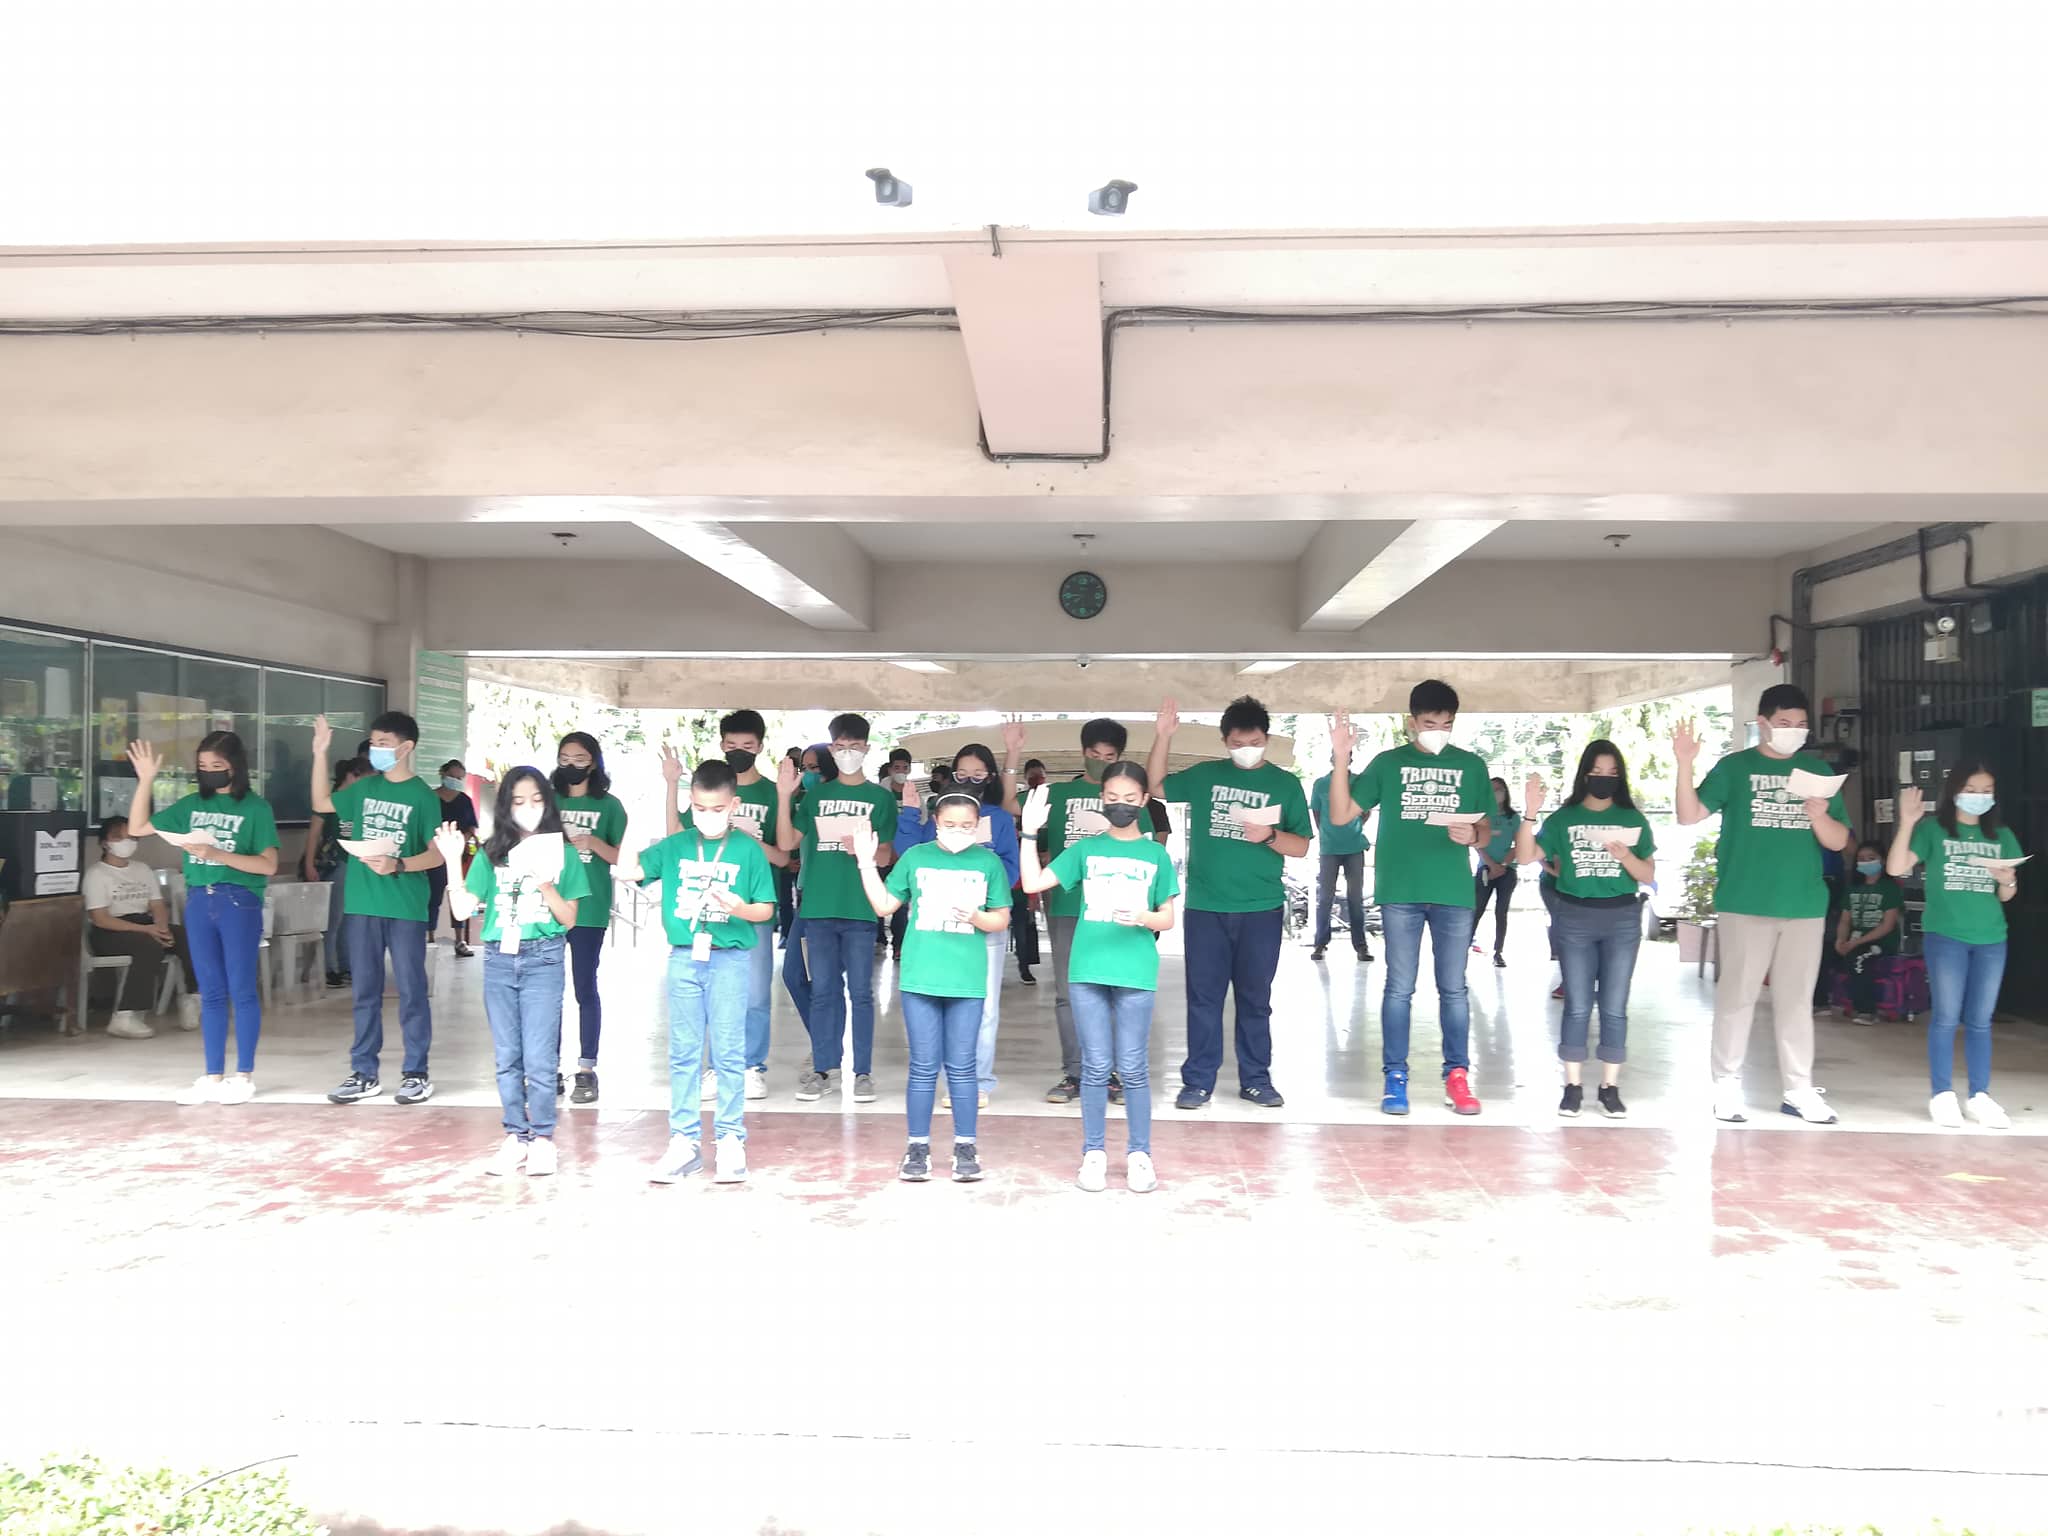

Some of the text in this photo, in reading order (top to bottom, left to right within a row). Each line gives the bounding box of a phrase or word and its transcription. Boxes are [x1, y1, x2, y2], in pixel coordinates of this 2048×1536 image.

[1400, 767, 1463, 787] TRINITY
[1750, 774, 1790, 791] TRIN
[1065, 798, 1104, 814] TRINI
[1211, 785, 1270, 808] TRINITY
[362, 798, 413, 824] TRINITY
[818, 800, 875, 819] TRINITY
[1751, 799, 1805, 814] SEEKIN
[191, 811, 245, 833] TRINITY
[1943, 840, 2002, 858] TRINITY
